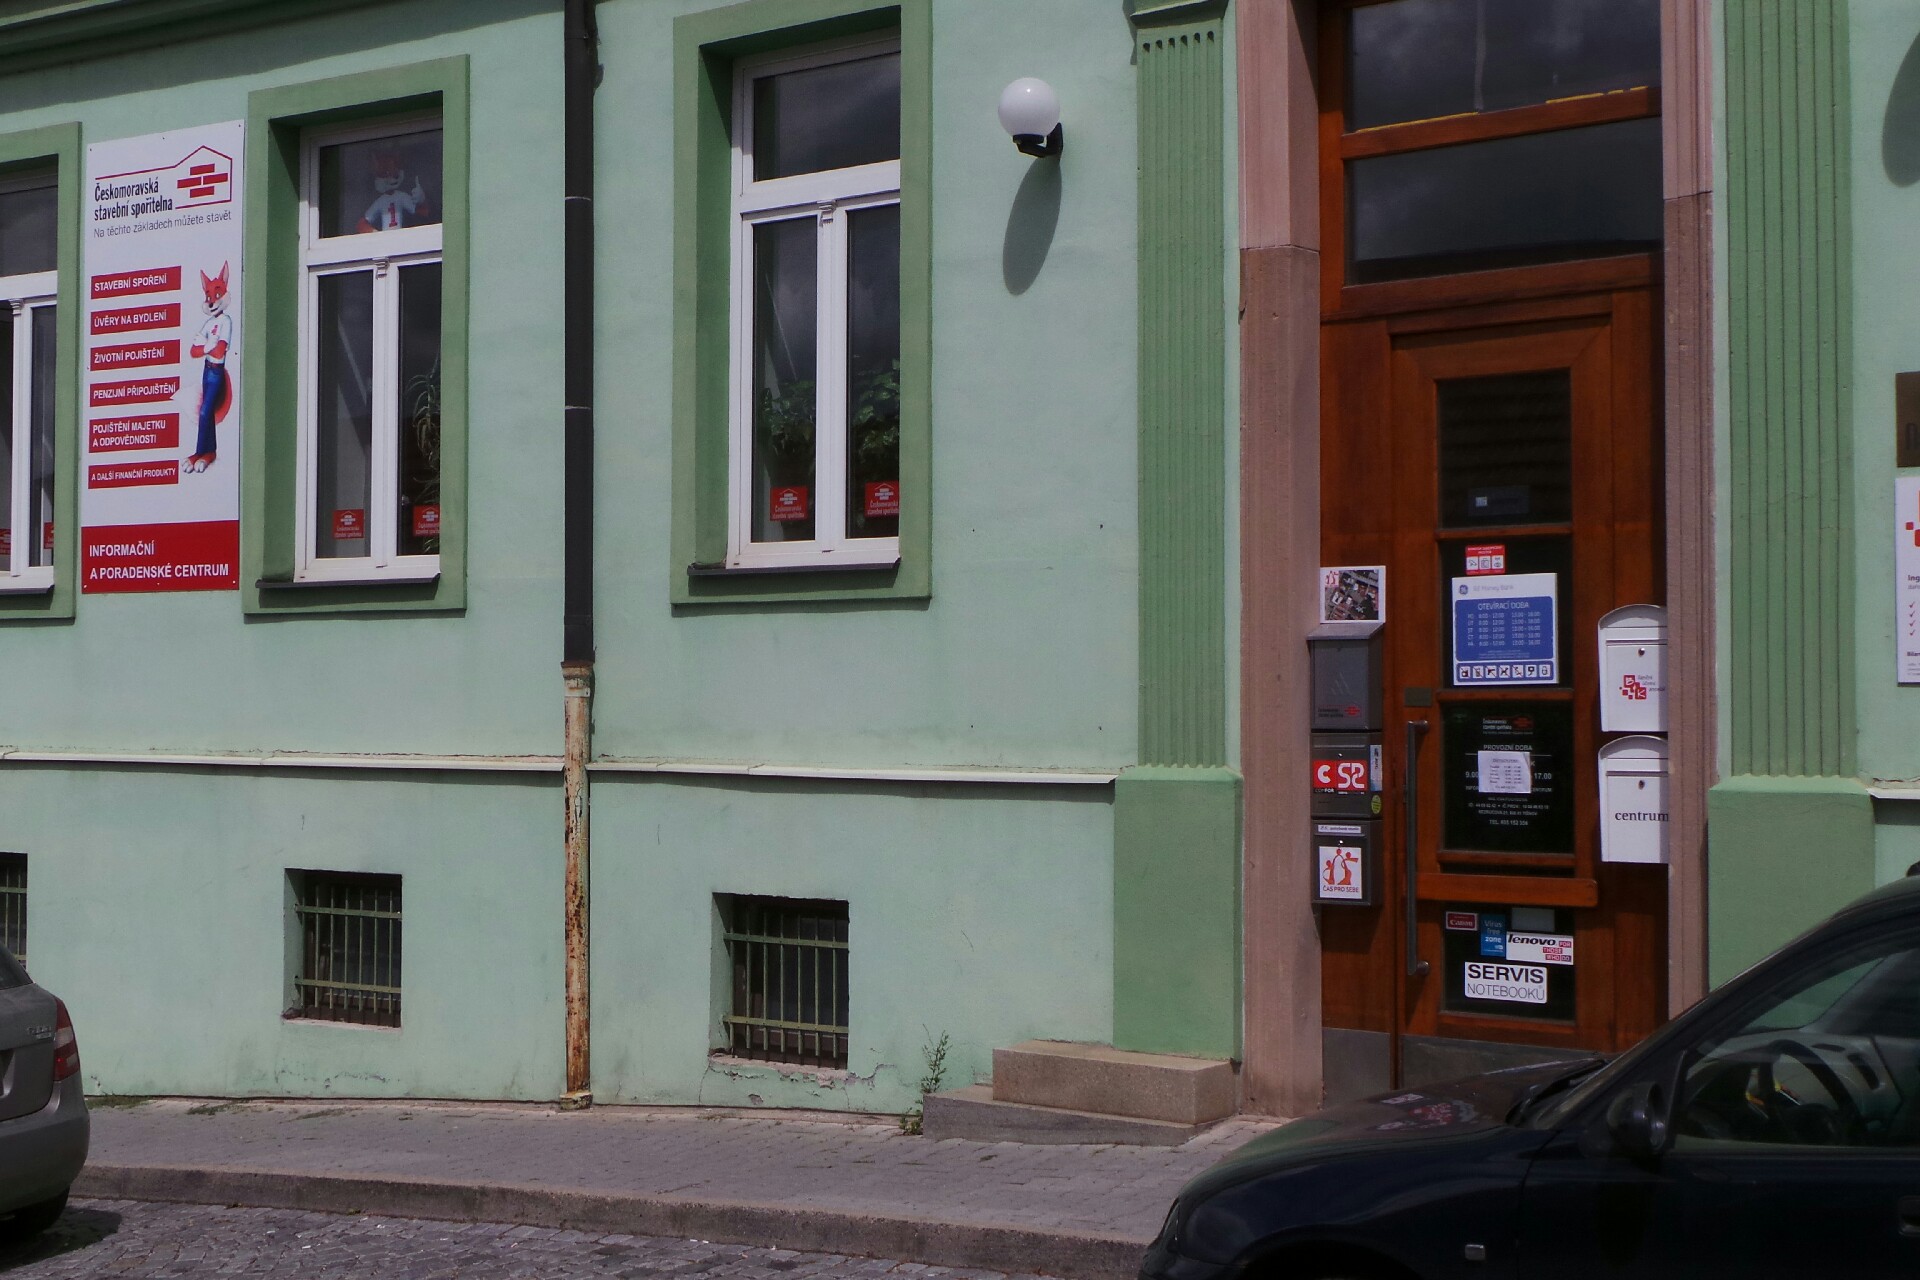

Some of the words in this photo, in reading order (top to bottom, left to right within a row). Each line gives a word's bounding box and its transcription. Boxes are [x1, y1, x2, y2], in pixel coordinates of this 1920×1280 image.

[94, 177, 159, 202] Českomoravská
[94, 199, 129, 221] stavební
[130, 195, 173, 218] spořitelna
[94, 227, 105, 238] Na
[107, 223, 131, 237] těchto
[133, 219, 173, 234] základech
[174, 215, 204, 227] můžete
[206, 210, 231, 223] stavět
[94, 276, 131, 292] STAVEBNÍ
[132, 273, 167, 287] SPOŘENÍ
[94, 313, 120, 328] ÚVĚRY
[120, 314, 132, 325] NA
[133, 309, 167, 323] BYDLENÍ
[94, 349, 124, 364] ŽIVOTNÍ
[124, 345, 165, 361] POJIŠTĚNÍ
[93, 386, 126, 400] PENZIJNÍ
[127, 384, 176, 398] PŘIPOJIŠTĚNÍ
[92, 422, 131, 434] POJIŠTĚNÍ
[131, 420, 166, 432] MAJETKU
[92, 438, 99, 447] A
[99, 434, 156, 446] ODPOVĚDNOSTI
[97, 470, 114, 480] DALŠÍ
[115, 469, 143, 480] FINANČNÍ
[143, 468, 176, 479] PRODUKTY
[89, 540, 155, 557] INFORMAČNÍ
[90, 569, 98, 579] A
[99, 563, 172, 579] PORADENSKÉ
[174, 564, 229, 578] CENTRUM
[1615, 811, 1668, 821] centrum
[1508, 934, 1556, 946] lenovo
[1468, 964, 1544, 984] SERVIS
[1467, 983, 1545, 1001] NOTEBOOKŮ
